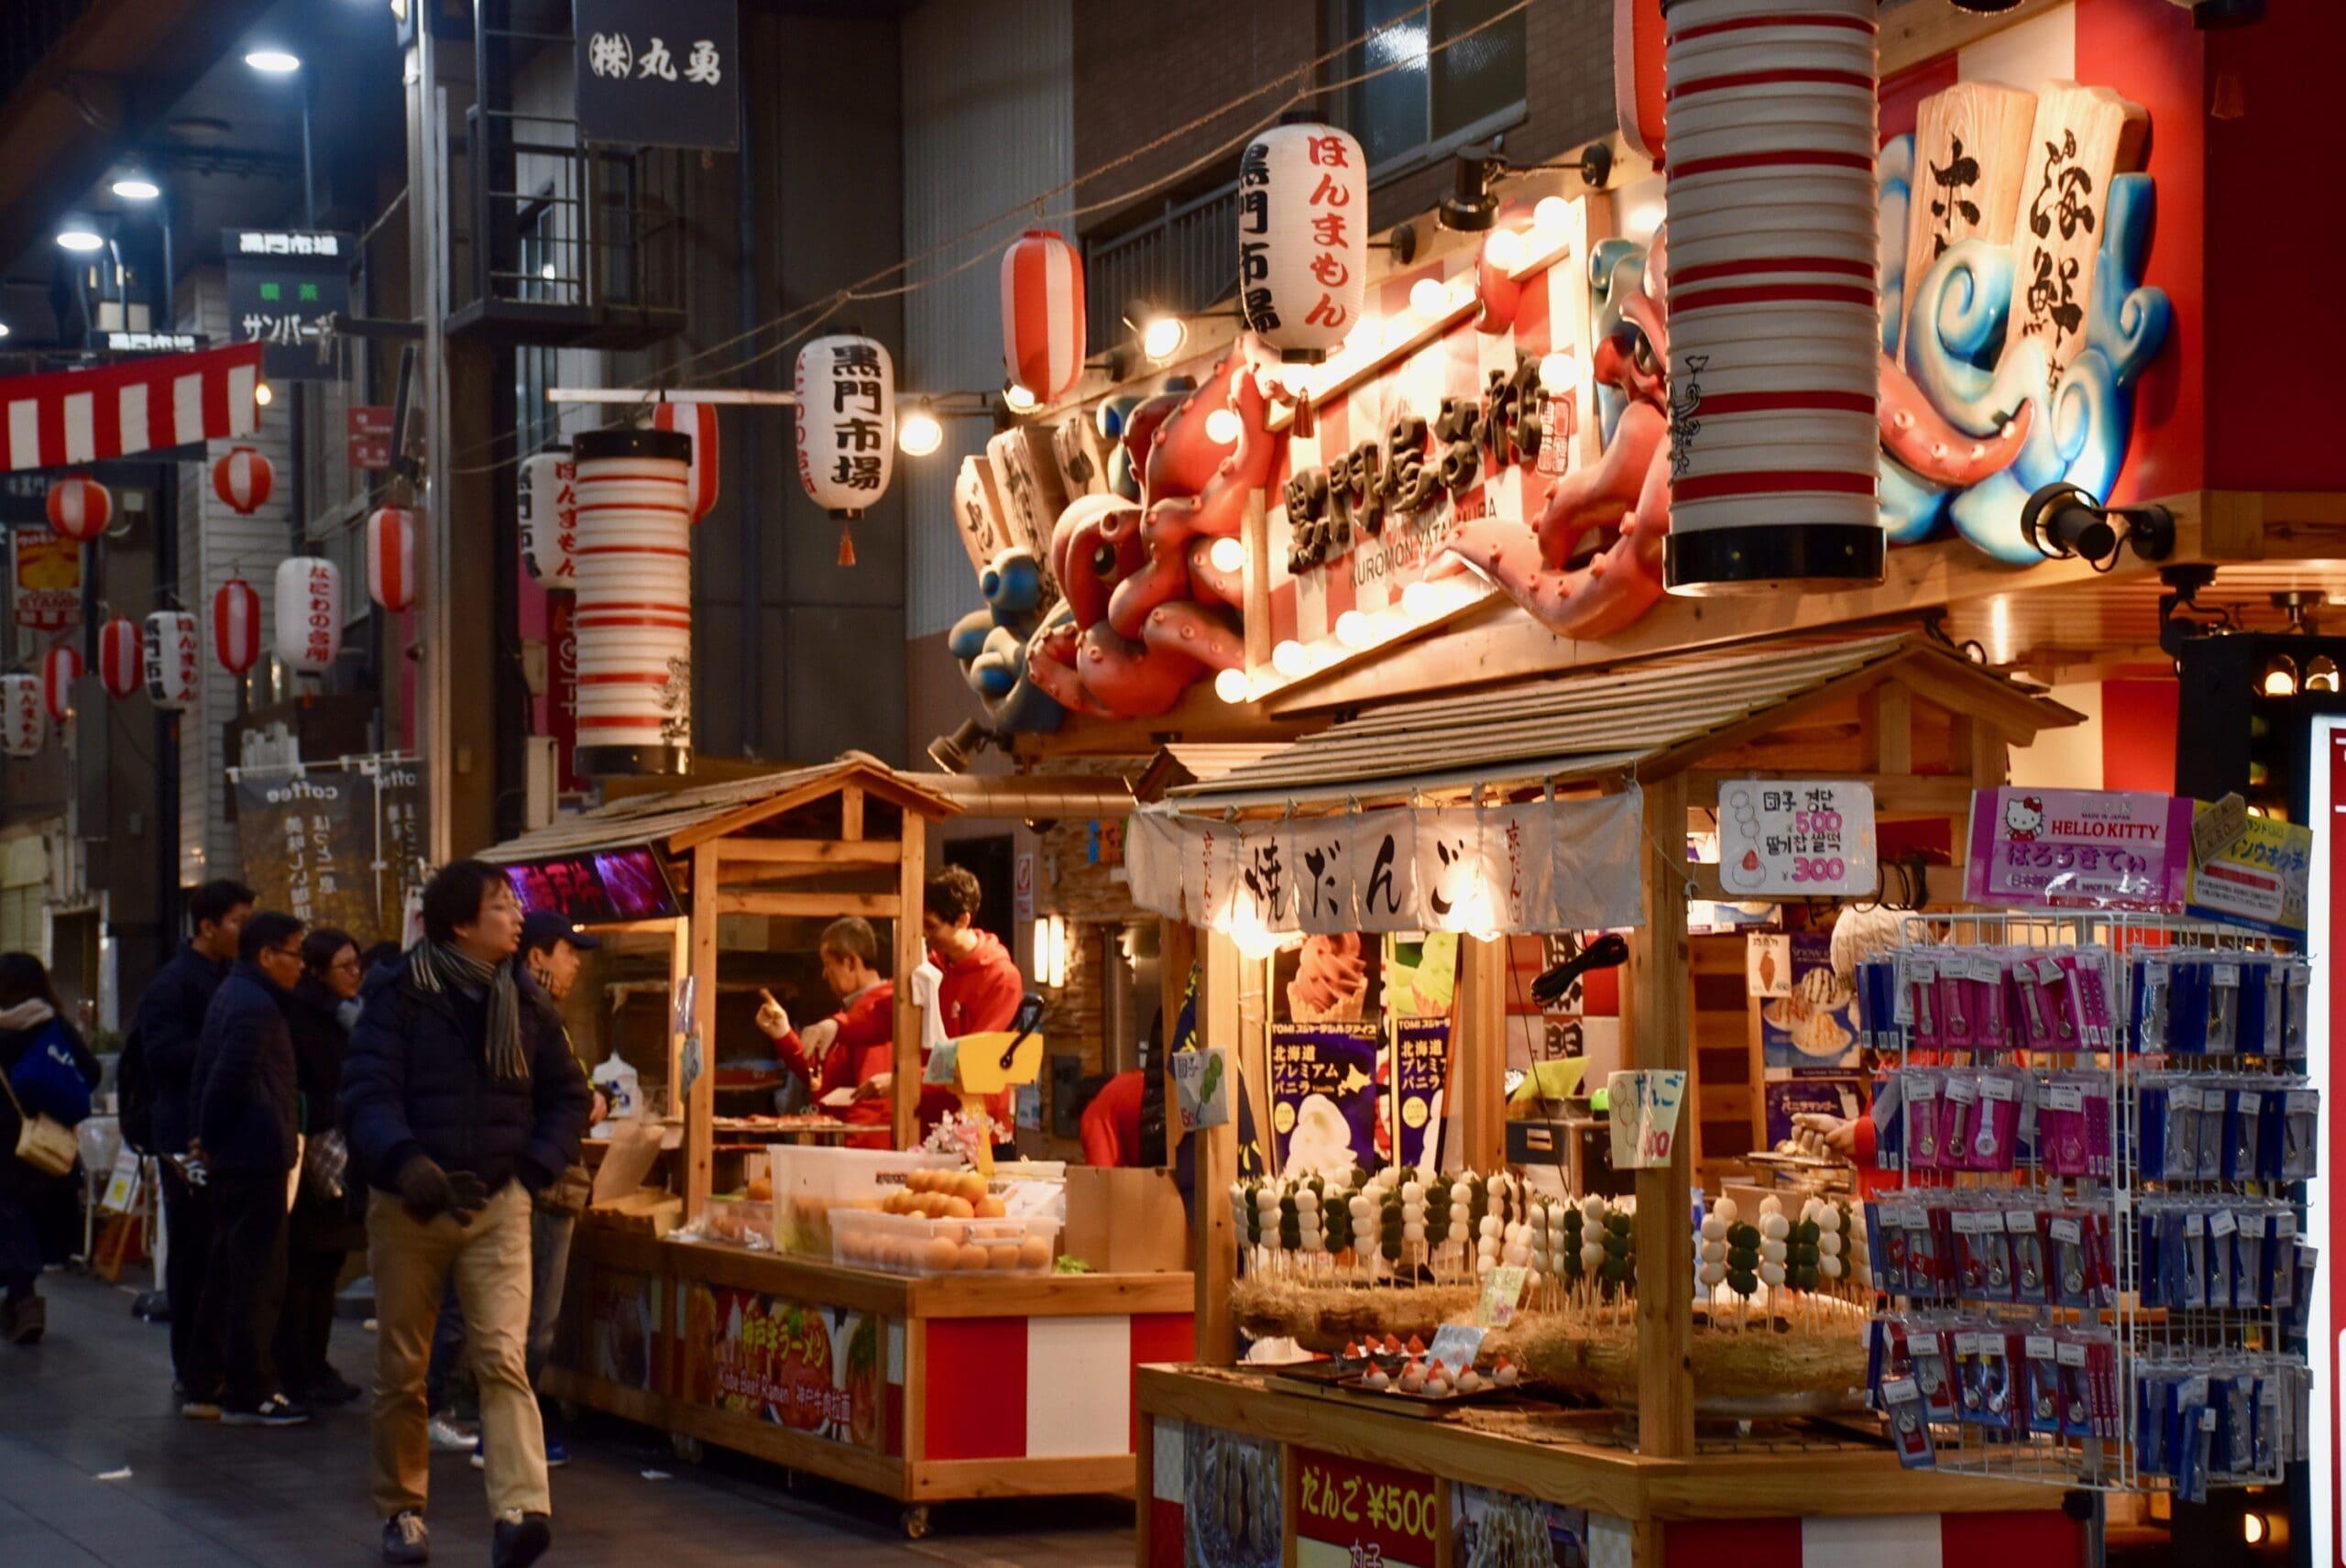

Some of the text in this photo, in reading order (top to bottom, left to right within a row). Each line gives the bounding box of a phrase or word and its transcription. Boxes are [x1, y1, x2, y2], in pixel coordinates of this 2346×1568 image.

[1305, 135, 1350, 328] ほんまもん
[829, 344, 883, 491] 黒門市場
[2050, 820, 2161, 840] HELLO KITTY
[1273, 1045, 1317, 1063] 北海道
[1400, 1038, 1443, 1058] 北海道
[1273, 1062, 1340, 1080] プレミアム
[1275, 1080, 1310, 1096] バニラ
[1401, 1075, 1441, 1091] バニラ
[1301, 1465, 1363, 1523] だんご
